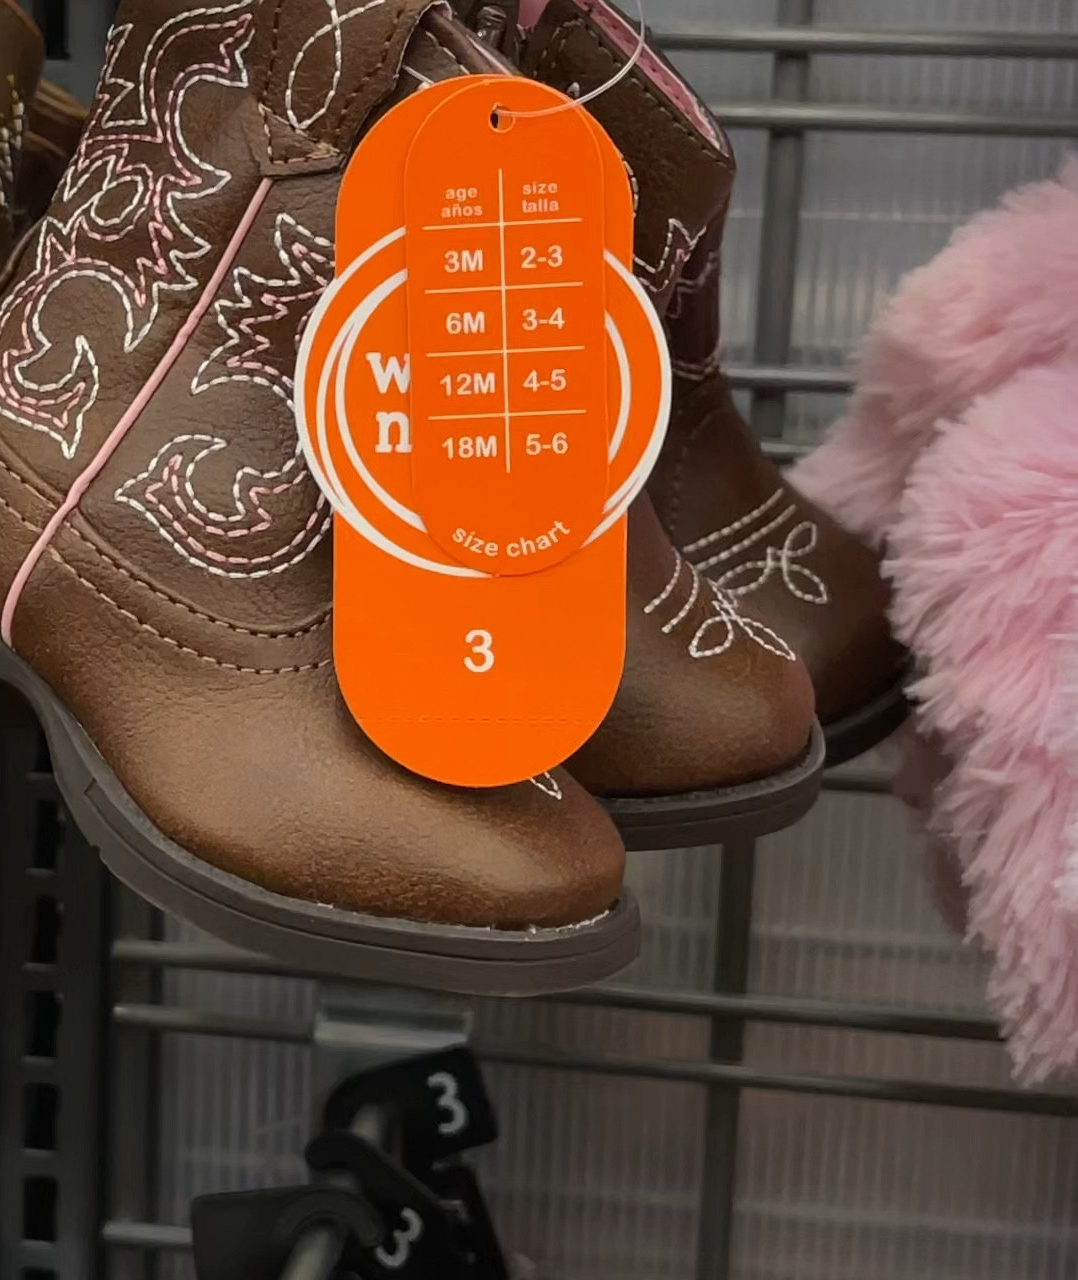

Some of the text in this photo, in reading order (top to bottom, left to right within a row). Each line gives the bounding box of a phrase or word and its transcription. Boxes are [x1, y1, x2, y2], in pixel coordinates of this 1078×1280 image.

[445, 180, 559, 203] age size
[440, 196, 560, 218] años talla
[443, 245, 563, 273] 3M 2-3
[445, 308, 565, 335] 6M 3-4
[439, 368, 567, 397] 12M 4-5
[441, 431, 569, 461] 18M 5-6
[451, 519, 572, 559] size chart
[463, 628, 495, 673] 3
[427, 1072, 468, 1135] 3
[375, 1208, 421, 1268] 3
